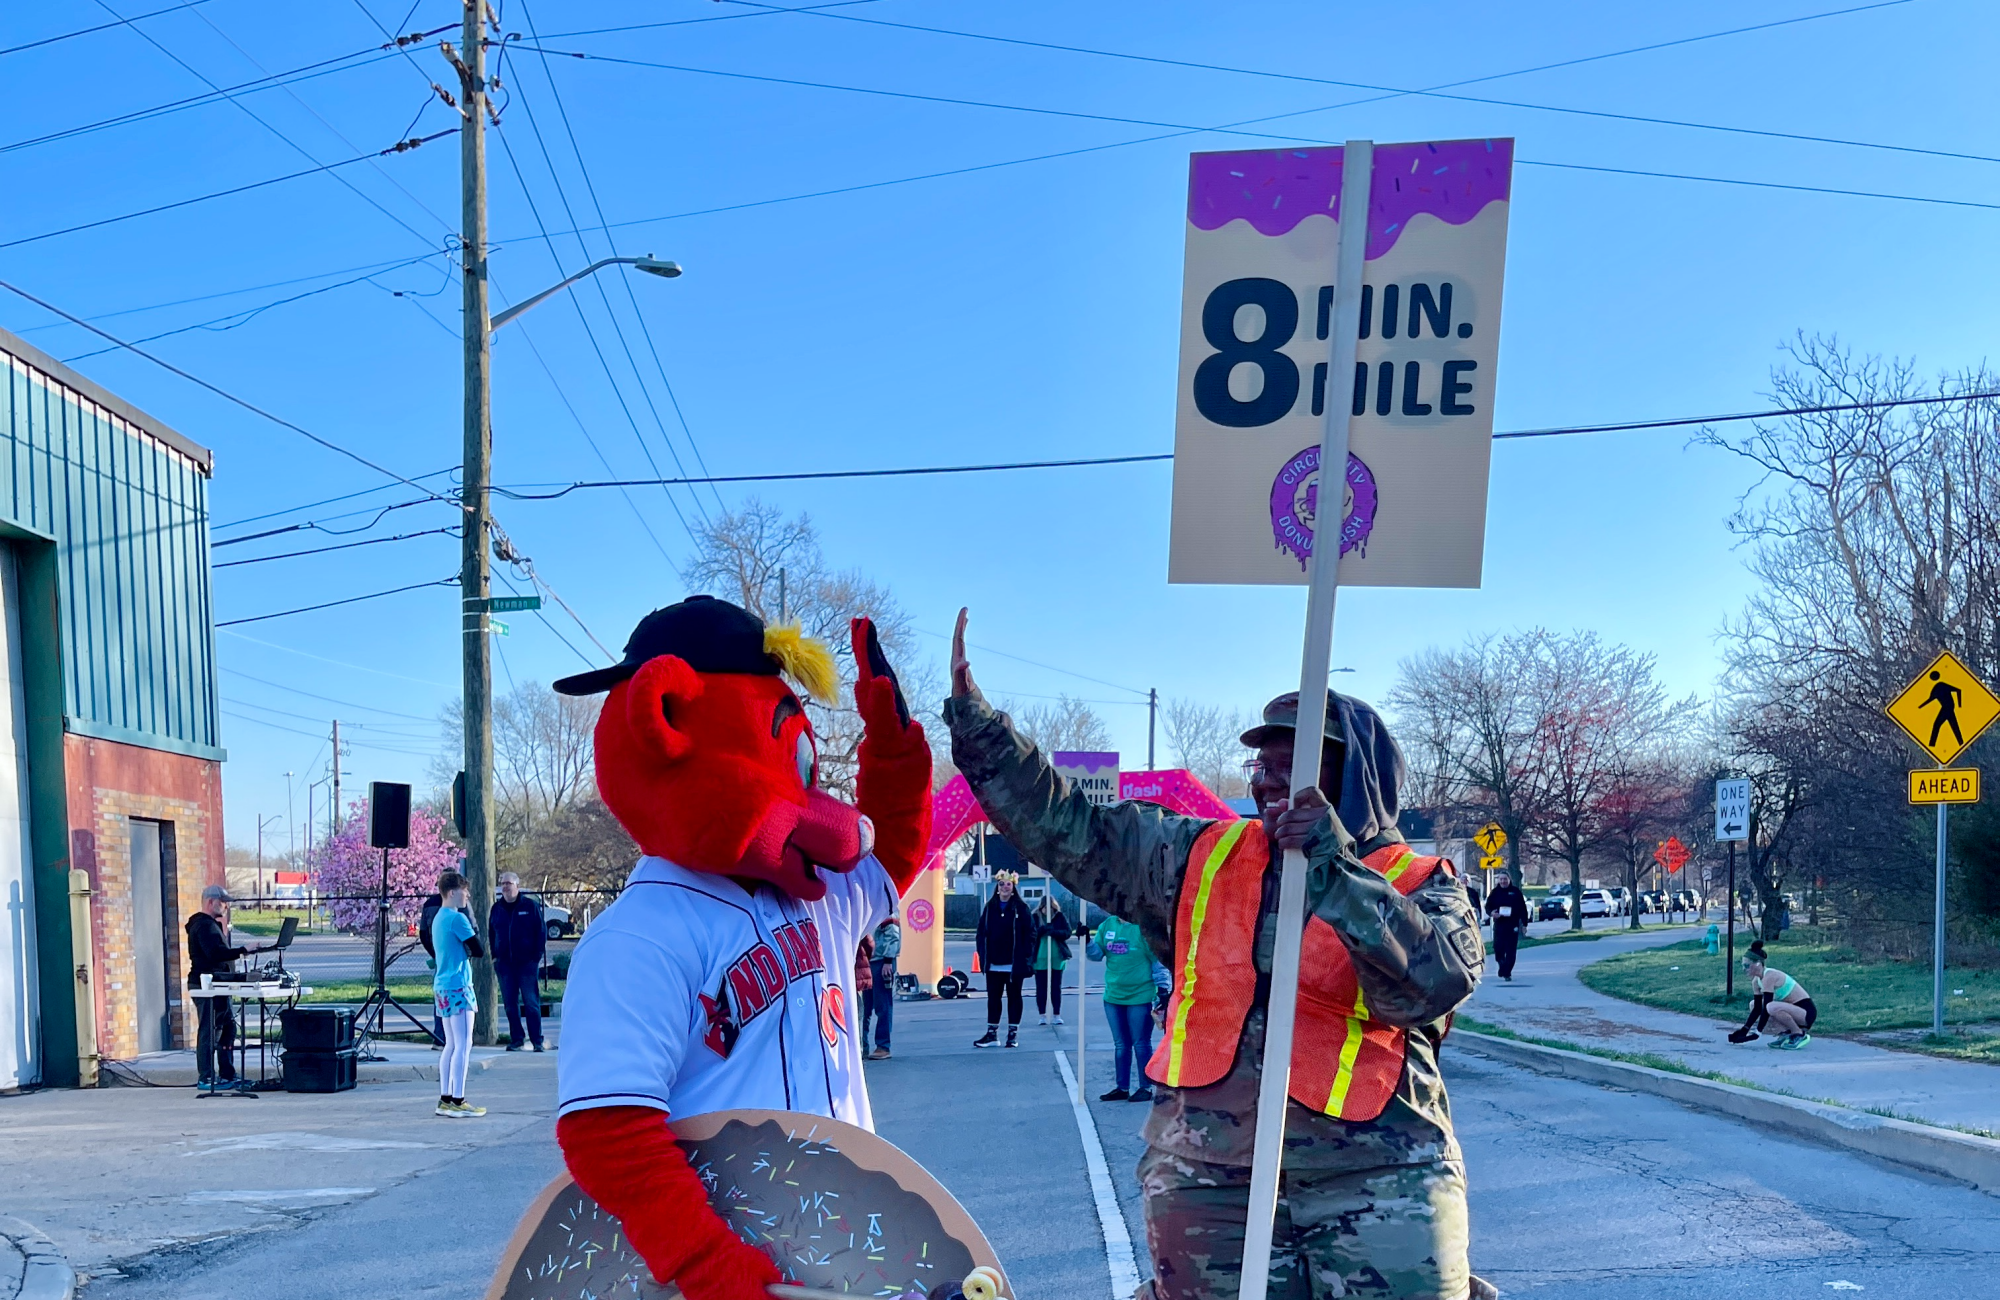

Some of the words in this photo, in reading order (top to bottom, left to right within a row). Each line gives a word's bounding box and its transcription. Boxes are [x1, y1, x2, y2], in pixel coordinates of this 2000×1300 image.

[1193, 277, 1300, 428] 8
[1282, 452, 1321, 485] CIRCL
[1278, 515, 1314, 550] DONU
[1340, 515, 1364, 546] ASH
[493, 599, 528, 609] Newman
[1081, 778, 1114, 791] MIN.
[1122, 782, 1163, 798] Dash
[1917, 777, 1970, 794] AHEAD
[1721, 785, 1745, 801] ONE
[1720, 804, 1746, 819] WAY
